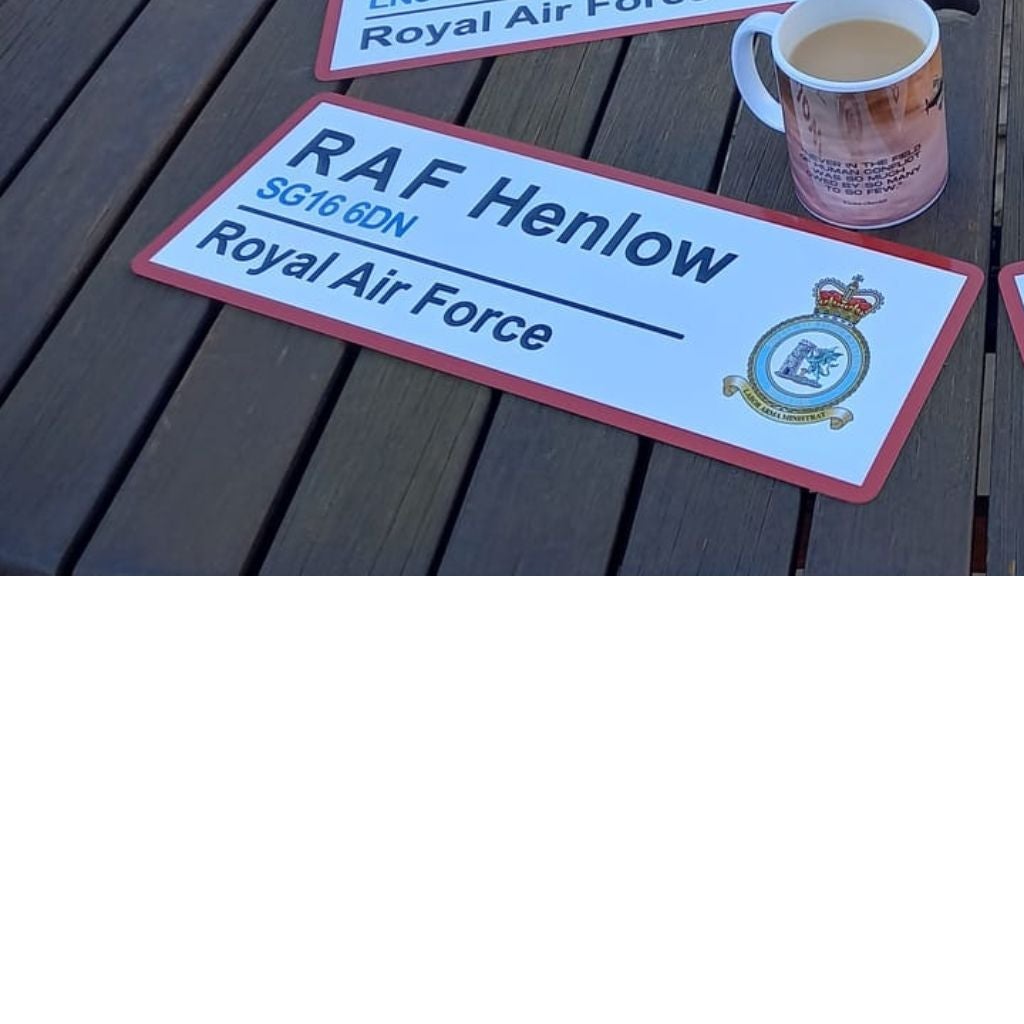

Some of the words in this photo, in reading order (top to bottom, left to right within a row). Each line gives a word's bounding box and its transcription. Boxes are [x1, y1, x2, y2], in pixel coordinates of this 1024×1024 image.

[360, 10, 492, 51] Royal
[505, 2, 573, 30] Air
[286, 127, 468, 200] RAF
[467, 176, 740, 285] Henlow
[887, 164, 921, 185] MANY
[257, 176, 347, 217] SG16
[342, 202, 419, 239] 6DN
[195, 219, 341, 284] Royal
[326, 261, 413, 306] Air
[410, 282, 553, 351] Force
